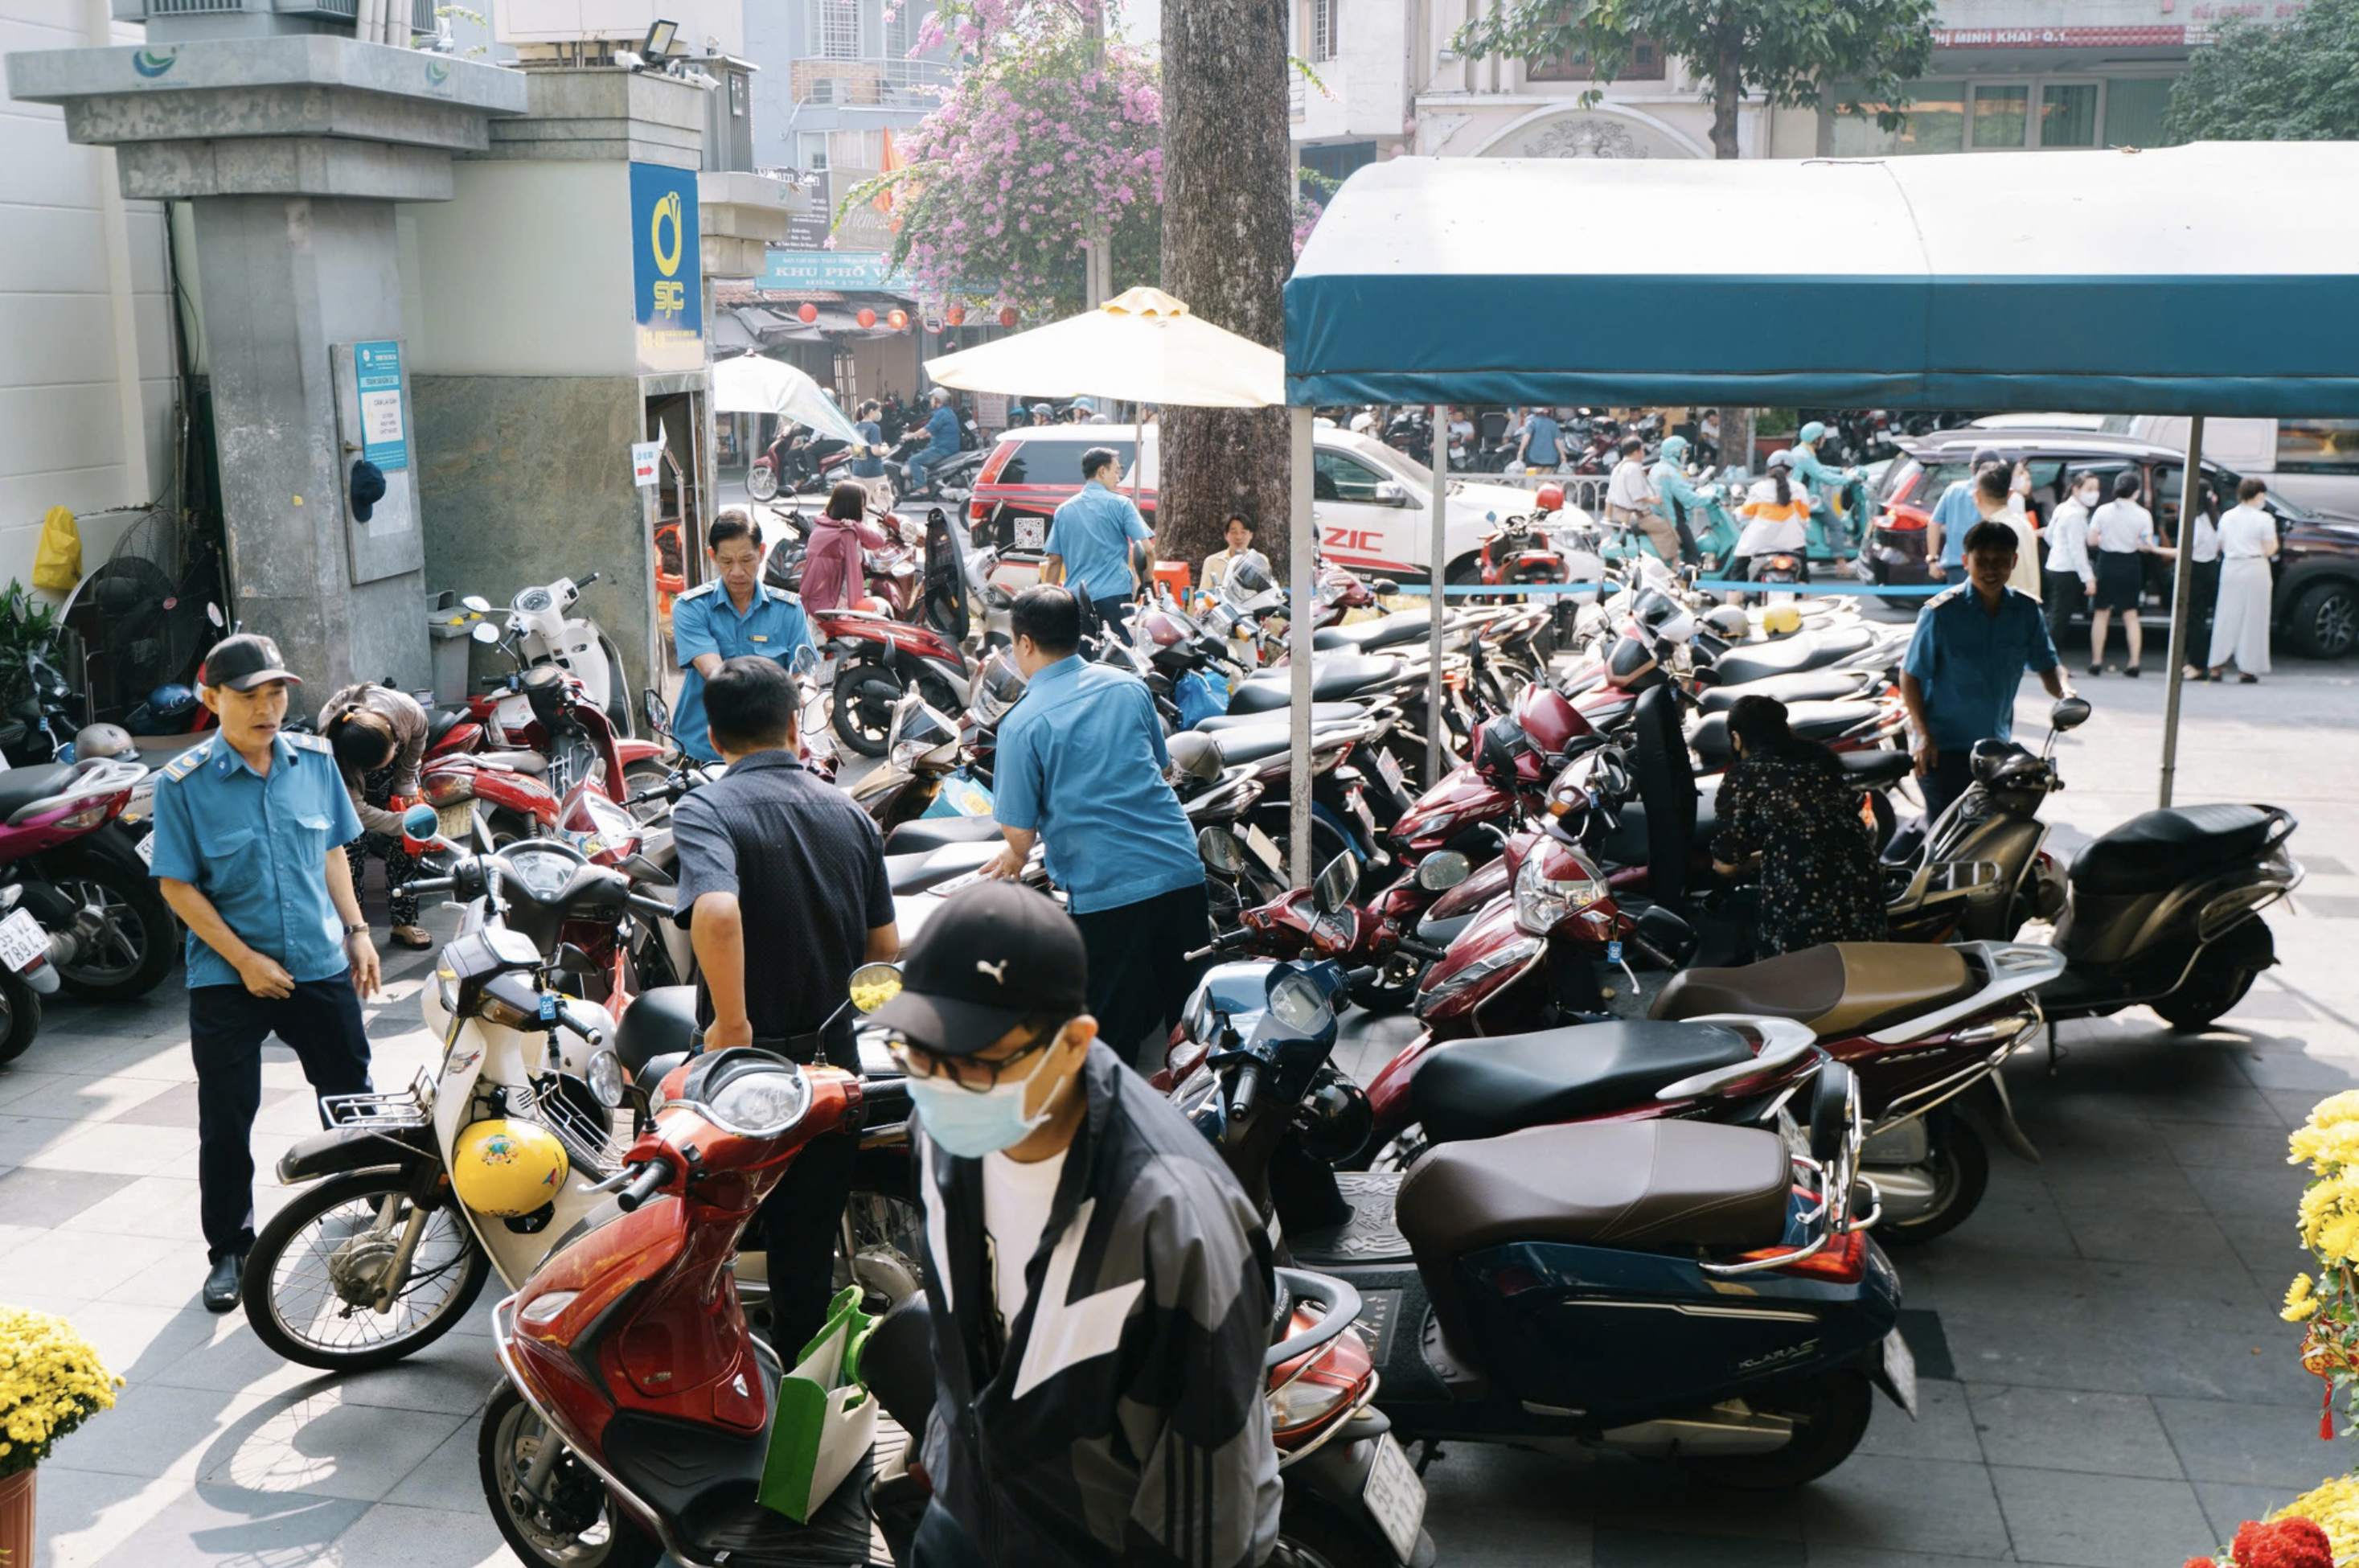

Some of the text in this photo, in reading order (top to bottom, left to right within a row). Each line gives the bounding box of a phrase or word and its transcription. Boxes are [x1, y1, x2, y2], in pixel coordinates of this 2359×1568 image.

[1955, 32, 1992, 43] MINH
[1996, 31, 2032, 43] KHAI
[2042, 31, 2067, 43] Q.1
[776, 267, 818, 277] KHU
[825, 264, 866, 277] PHỐ
[654, 281, 684, 318] SJC
[1323, 527, 1384, 552] ZIC
[542, 1000, 553, 1015] 33
[1371, 1445, 1404, 1515] 59-C2
